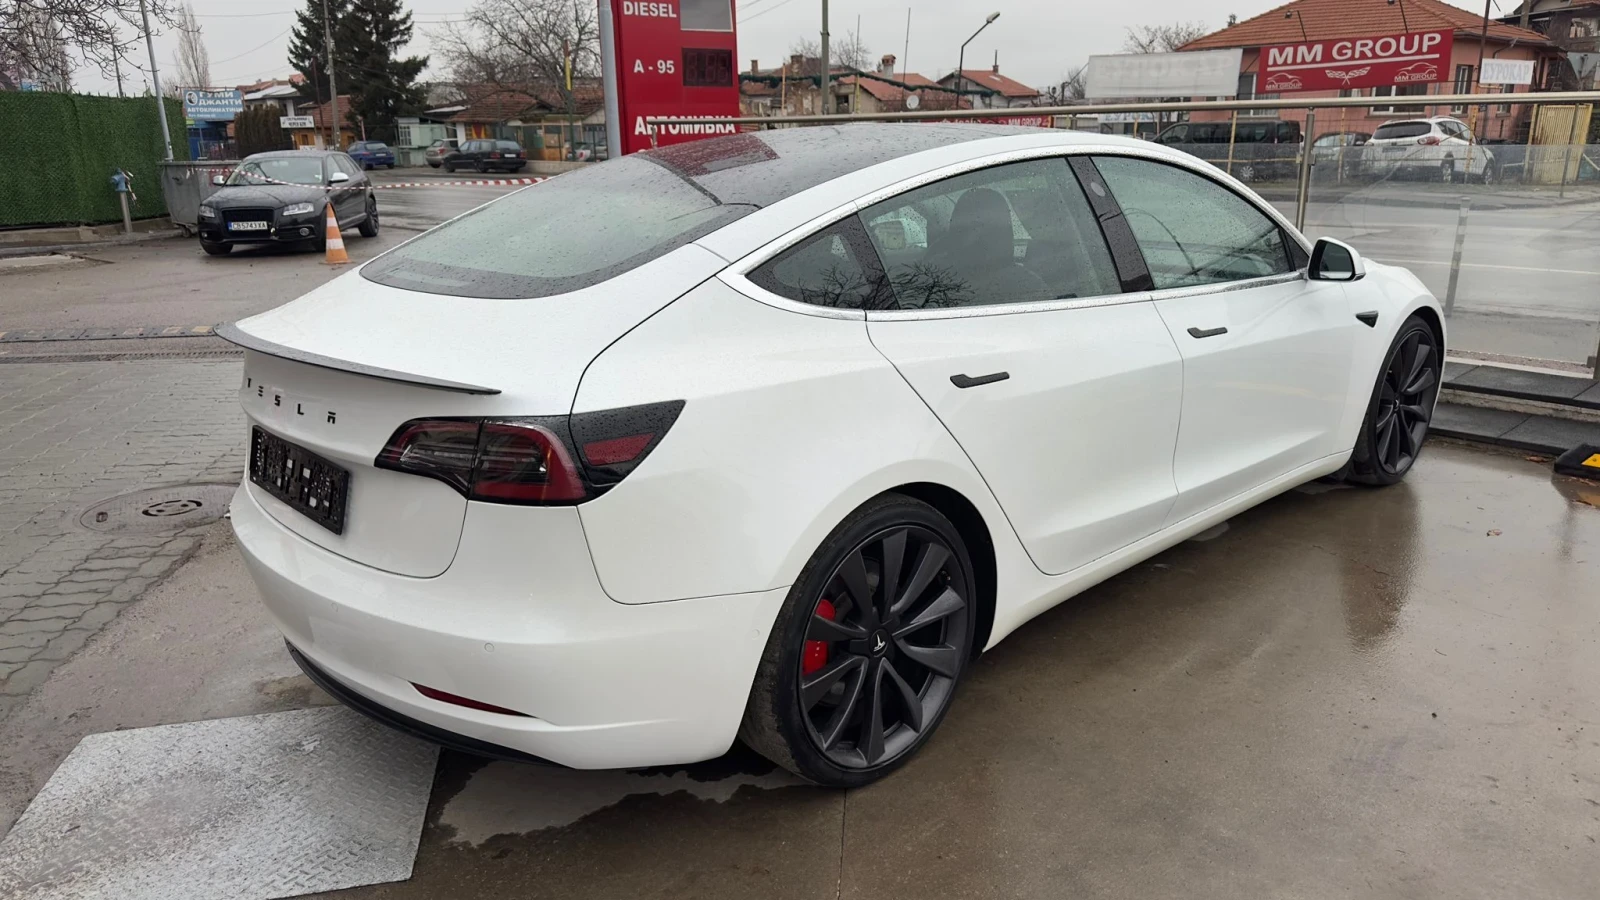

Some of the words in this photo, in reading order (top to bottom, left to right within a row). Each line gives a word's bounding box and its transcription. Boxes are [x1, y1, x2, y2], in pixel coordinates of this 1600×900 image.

[623, 1, 677, 18] DIESEL
[1267, 43, 1323, 66] MM
[1331, 33, 1442, 61] GROUP
[1410, 73, 1437, 81] GROUP
[199, 98, 242, 106] ДЖАНТИ
[247, 377, 337, 425] TESLA
